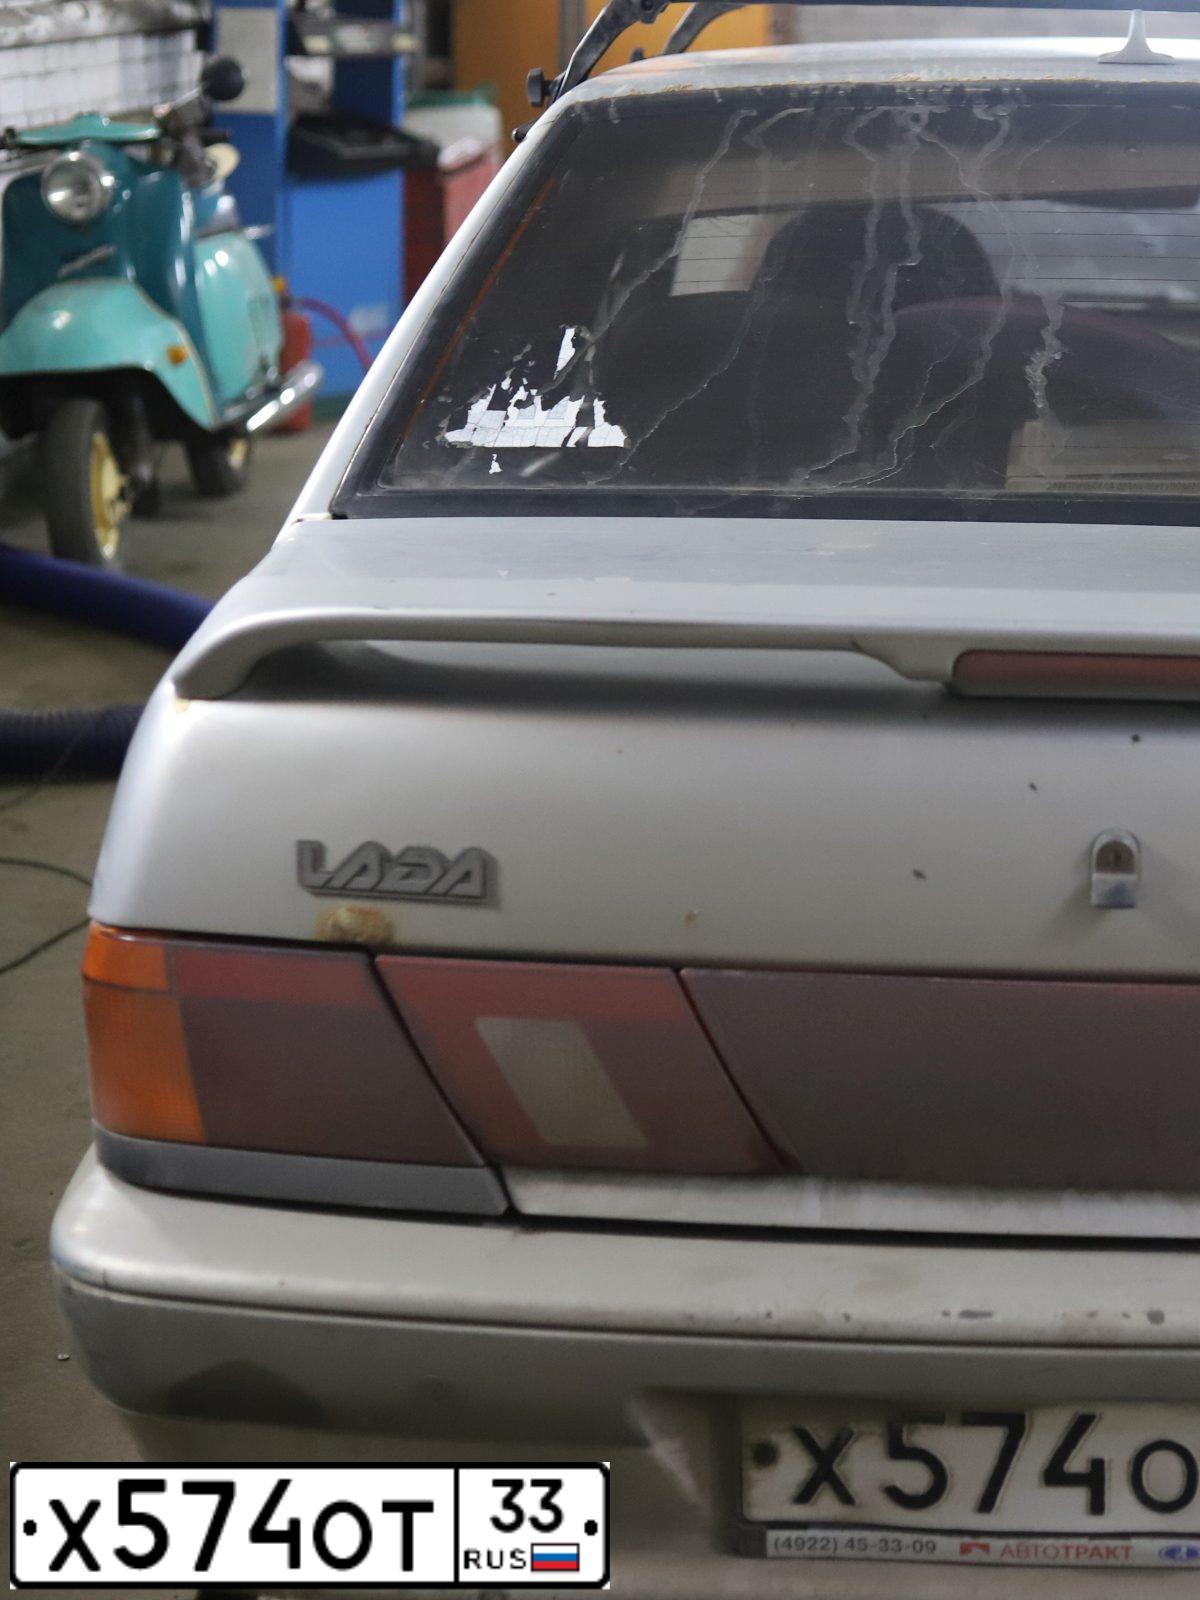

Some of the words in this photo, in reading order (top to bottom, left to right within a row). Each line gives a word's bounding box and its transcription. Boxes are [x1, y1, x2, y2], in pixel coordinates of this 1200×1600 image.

[297, 840, 498, 907] LADA
[773, 1536, 839, 1555] (4922)
[844, 1537, 938, 1555] 45-33-09
[1001, 1542, 1133, 1562] АВТОТРАКТ
